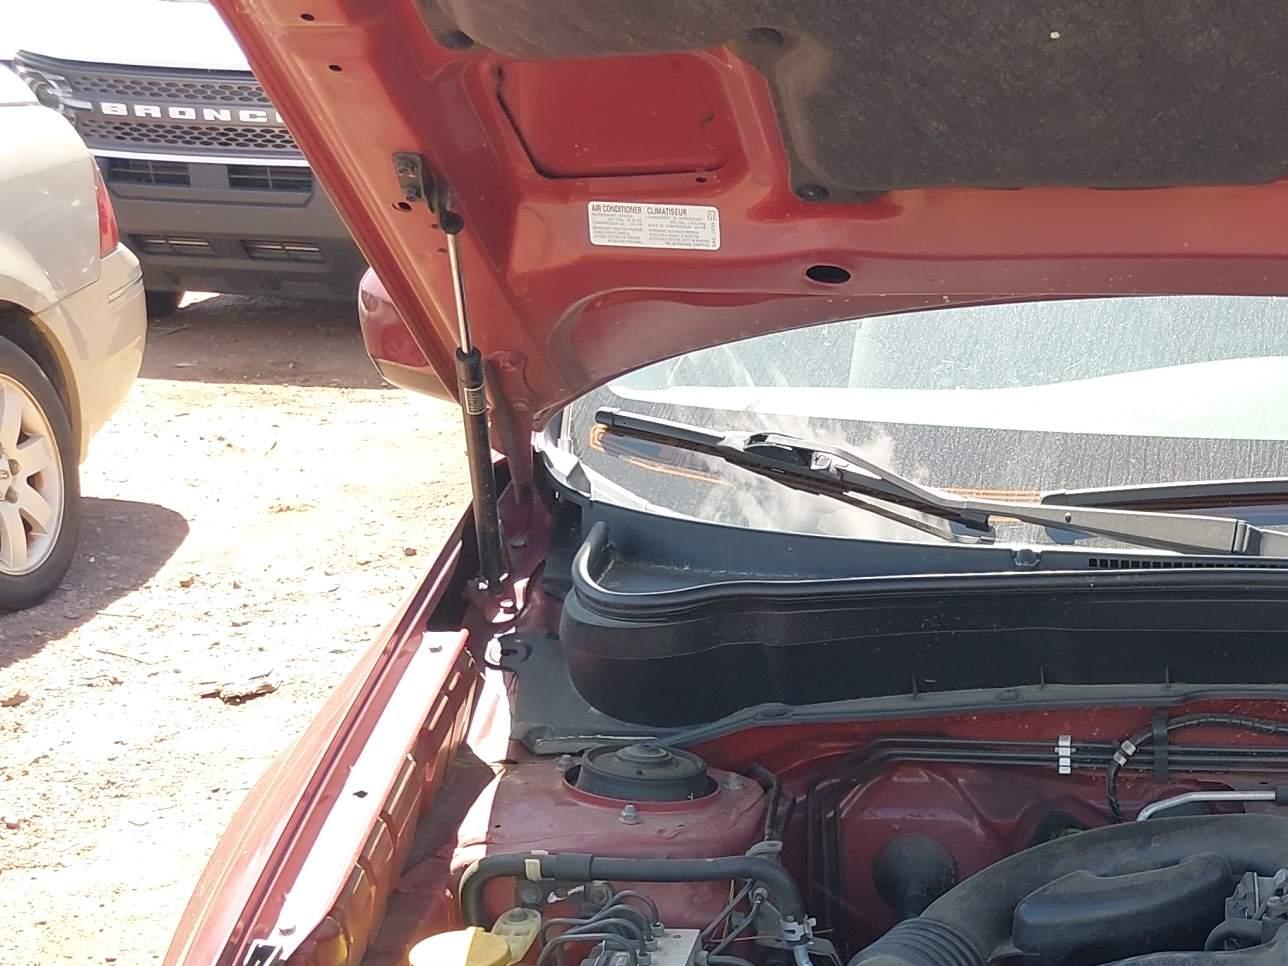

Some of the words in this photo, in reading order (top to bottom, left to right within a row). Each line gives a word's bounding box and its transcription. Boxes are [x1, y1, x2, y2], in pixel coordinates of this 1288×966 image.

[100, 102, 286, 123] BRONC
[591, 203, 602, 212] AIR
[602, 204, 642, 215] CONDITIONER
[646, 206, 688, 217] CLIMATISEUR
